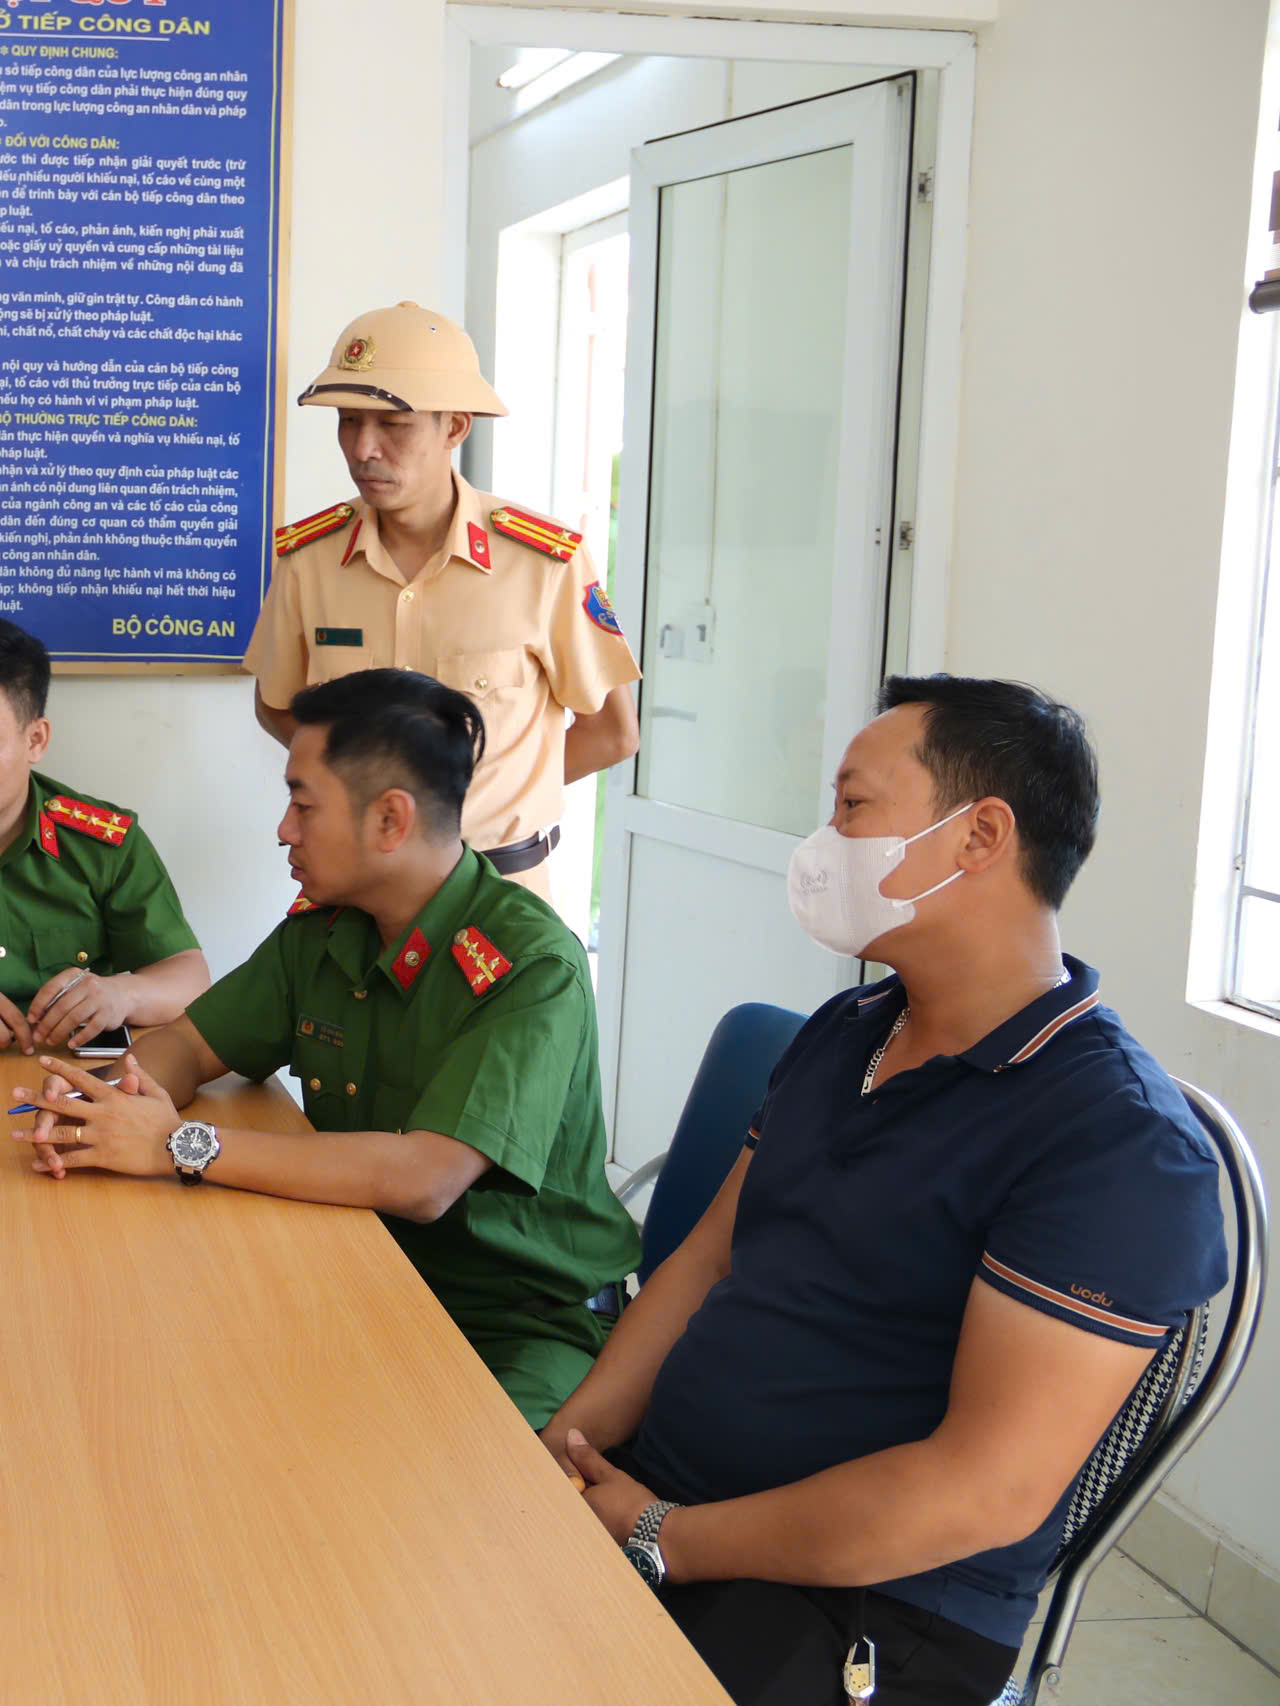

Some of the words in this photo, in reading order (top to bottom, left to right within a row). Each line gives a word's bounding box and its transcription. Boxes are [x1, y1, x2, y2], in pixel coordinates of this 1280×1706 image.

[18, 11, 72, 30] TIẾP
[79, 14, 152, 32] CÔNG
[159, 16, 210, 34] DÂN
[11, 45, 37, 56] QUY
[39, 46, 69, 60] ĐỊNH
[71, 46, 118, 58] CHUNG:
[4, 62, 20, 76] sở
[20, 63, 43, 78] tiếp
[43, 65, 73, 79] công
[74, 66, 96, 78] dân
[97, 64, 119, 78] của
[120, 67, 138, 81] lực
[139, 68, 172, 83] lượng
[173, 69, 202, 83] công
[203, 72, 218, 81] an
[219, 70, 248, 82] nhân
[19, 84, 34, 96] vụ
[35, 81, 58, 96] tiếp
[59, 84, 89, 98] công
[90, 84, 112, 95] dân
[113, 84, 139, 98] phải
[140, 86, 166, 99] thực
[168, 87, 193, 101] hiện
[194, 86, 224, 101] đúng
[225, 90, 248, 101] quy
[4, 132, 27, 147] ĐỐI
[29, 134, 50, 148] VỚI
[52, 134, 89, 148] CÔNG
[90, 136, 120, 149] DÂN:
[8, 205, 33, 218] luật.
[5, 256, 19, 267] và
[22, 257, 47, 271] chịu
[50, 257, 79, 268] trách
[82, 258, 117, 272] nhiệm
[120, 258, 134, 270] về
[137, 259, 174, 273] những
[176, 260, 195, 274] nội
[197, 261, 227, 275] dung
[229, 261, 244, 273] đã
[14, 375, 27, 387] tố
[28, 377, 50, 388] cáo
[51, 377, 70, 388] với
[71, 375, 91, 388] thủ
[92, 376, 130, 392] trưởng
[132, 380, 155, 393] trực
[157, 378, 179, 393] tiếp
[180, 378, 202, 391] của
[203, 381, 224, 392] cán
[226, 381, 241, 394] bộ
[20, 395, 36, 408] họ
[37, 394, 52, 405] có
[54, 394, 83, 405] hành
[85, 395, 96, 406] vi
[98, 396, 109, 406] vi
[110, 396, 142, 409] phạm
[144, 397, 173, 410] pháp
[175, 397, 199, 410] luật.
[14, 411, 65, 425] THƯỜNG
[68, 413, 100, 427] TRỰC
[103, 411, 129, 425] TIẾP
[131, 413, 167, 427] CÔNG
[169, 414, 198, 427] DÂN:
[1, 496, 22, 509] của
[24, 498, 60, 513] ngành
[62, 499, 91, 512] công
[94, 502, 108, 511] an
[111, 500, 125, 511] và
[127, 500, 147, 511] các
[149, 498, 162, 511] tố
[163, 501, 185, 512] cáo
[187, 499, 208, 512] của
[210, 502, 238, 515] công
[0, 515, 21, 527] dân
[24, 514, 46, 526] đến
[49, 515, 78, 530] đúng
[81, 517, 96, 526] cơ
[99, 519, 128, 530] quan
[130, 517, 145, 528] có
[148, 514, 177, 528] thẩm
[180, 517, 214, 532] quyền
[217, 518, 238, 532] giải
[18, 583, 53, 596] không
[56, 582, 78, 596] tiếp
[81, 583, 109, 596] nhận
[112, 583, 143, 595] khiếu
[145, 584, 163, 598] nại
[166, 584, 185, 596] hết
[187, 585, 209, 596] thời
[212, 587, 236, 599] hiệu
[112, 615, 142, 639] BỘ
[145, 615, 204, 636] CÔNG
[207, 620, 235, 637] AN
